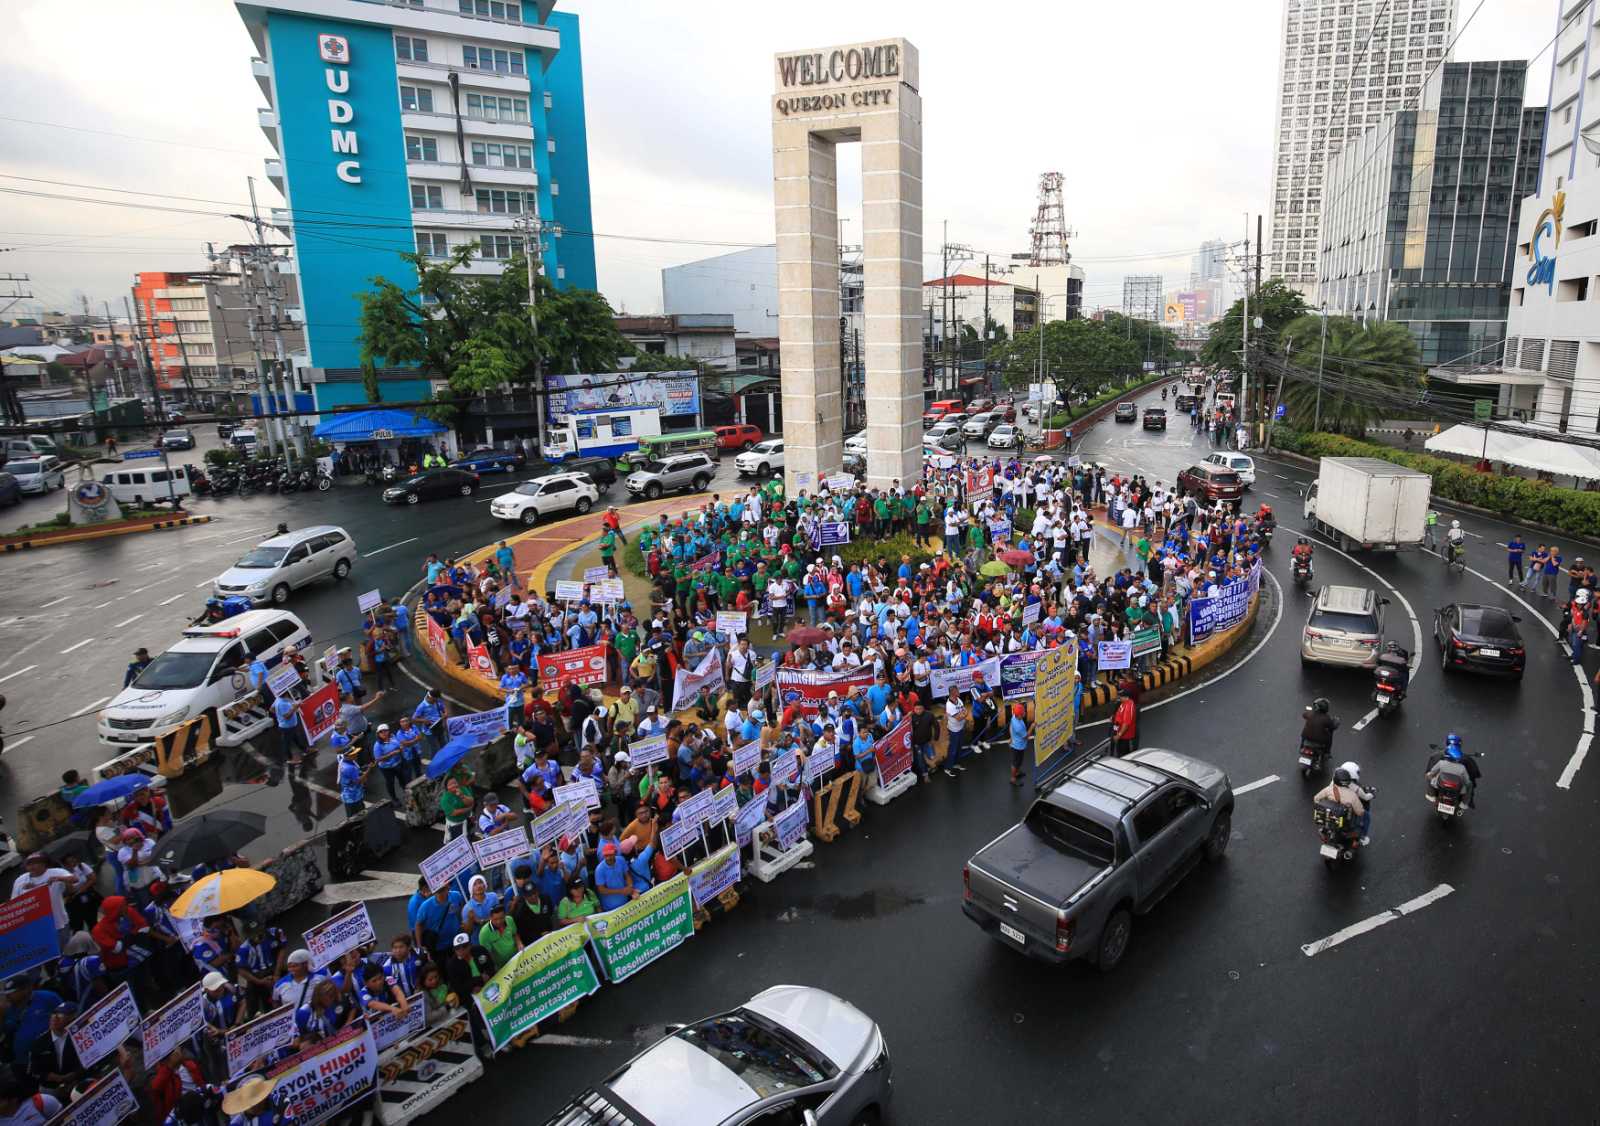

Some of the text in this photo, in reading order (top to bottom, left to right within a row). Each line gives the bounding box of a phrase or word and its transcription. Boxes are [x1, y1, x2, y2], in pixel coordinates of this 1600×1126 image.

[777, 44, 899, 87] WELCOME
[776, 89, 892, 116] QUEZON CITY
[324, 68, 362, 184] UDMC
[312, 943, 326, 957] YES
[332, 920, 369, 945] MODERNIZATION
[330, 911, 366, 934] SUSPENSION
[614, 914, 655, 945] SUPPORT
[644, 930, 661, 945] Ang
[661, 912, 687, 934] senate
[615, 945, 660, 978] Resolution
[538, 974, 572, 998] maayos
[98, 996, 131, 1026] SUSPENSION
[167, 996, 200, 1022] SUSPENSION
[510, 985, 578, 1029] transportasyon
[79, 1037, 95, 1053] YES
[146, 1036, 160, 1052] YES
[320, 1042, 367, 1076] HINDI
[290, 1056, 366, 1104] PENSYON
[320, 1081, 346, 1101] TO
[75, 1082, 124, 1121] SUSPENSION
[293, 1076, 369, 1126] ODERNIZATION
